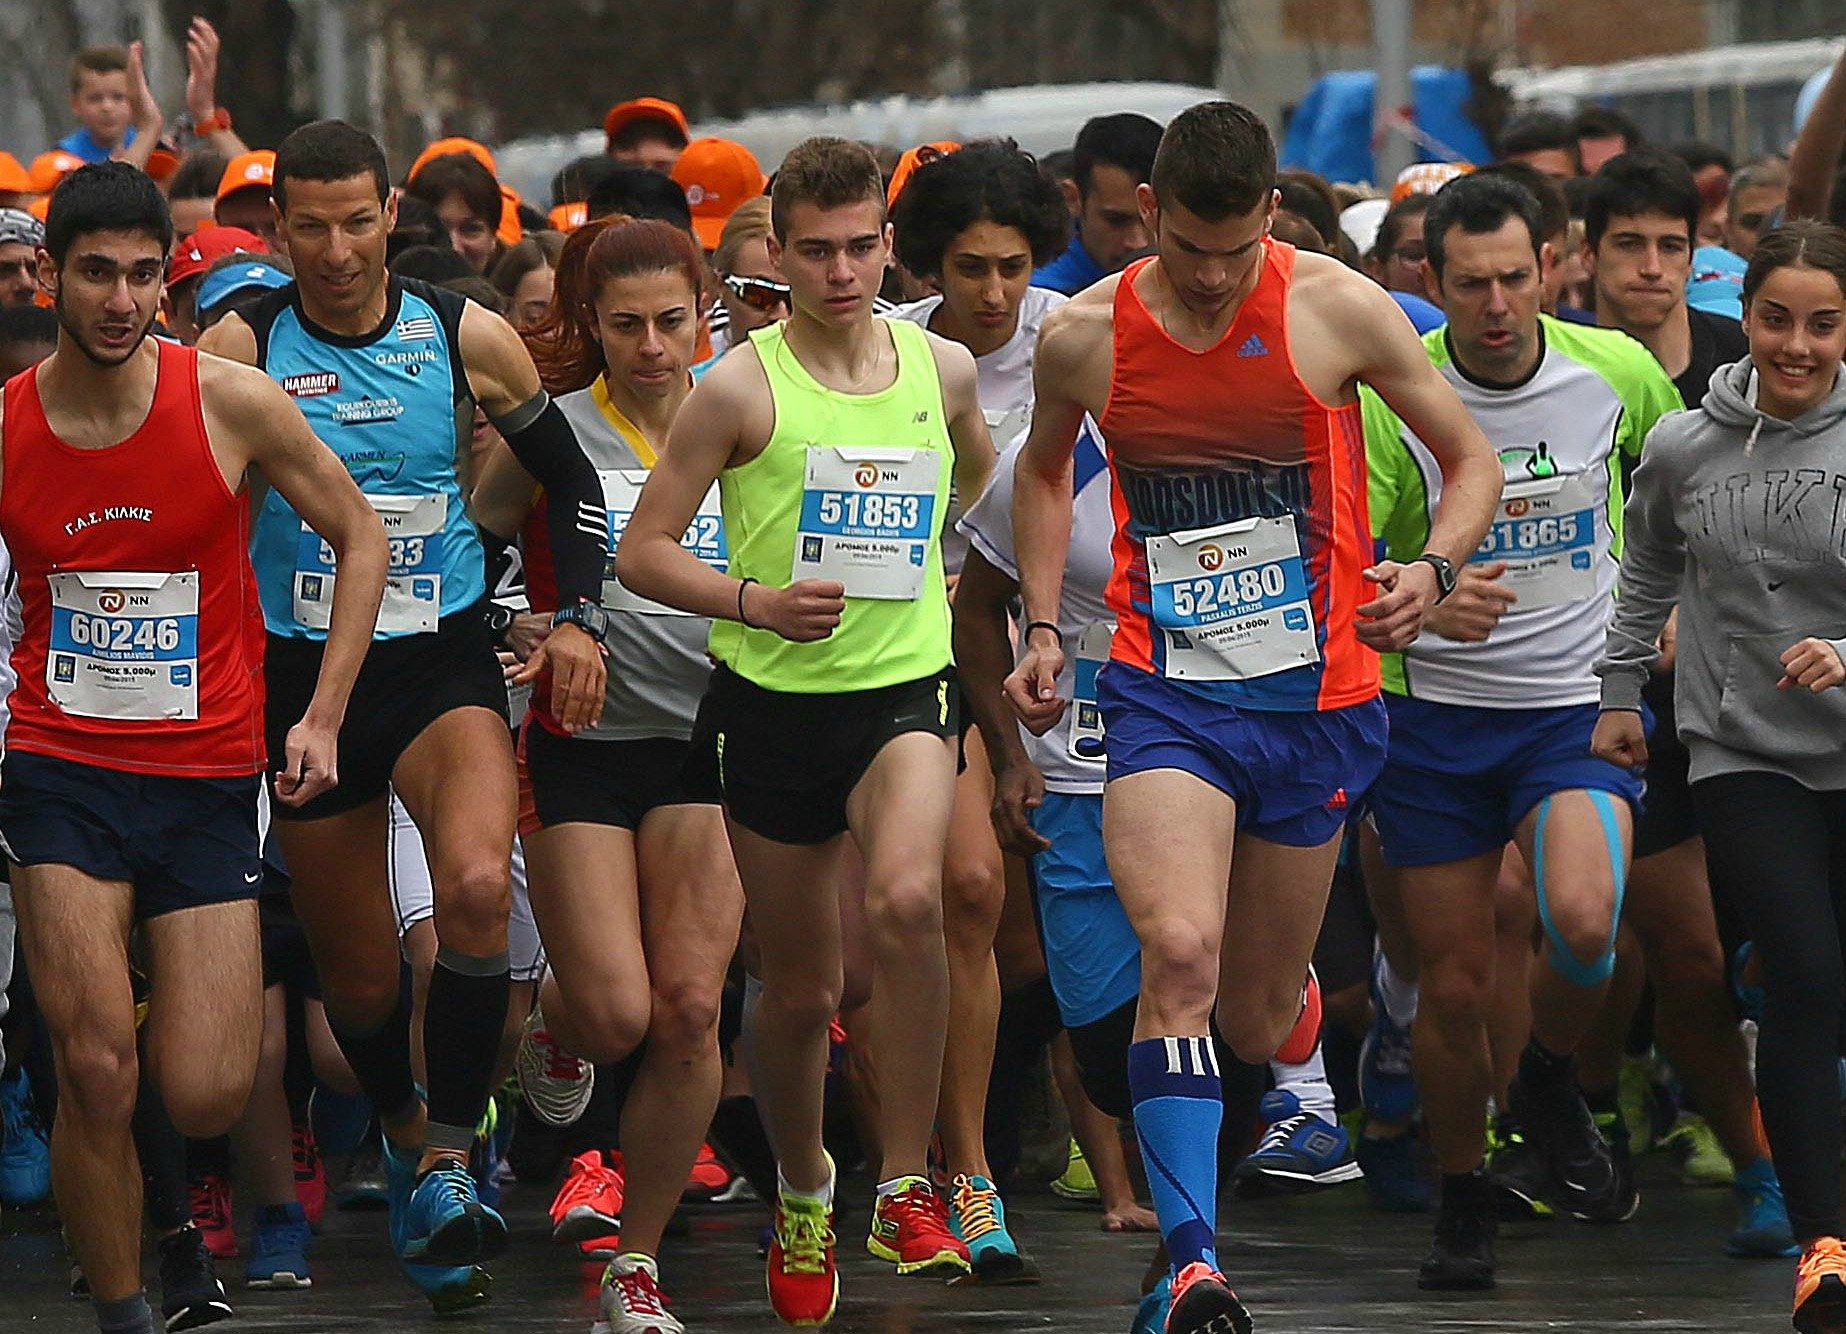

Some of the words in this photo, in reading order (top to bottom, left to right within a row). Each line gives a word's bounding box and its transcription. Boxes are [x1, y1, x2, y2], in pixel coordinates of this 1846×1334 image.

[375, 350, 436, 365] GARMIN
[284, 373, 337, 391] HAMMER
[881, 471, 899, 482] NN
[818, 492, 920, 530] 51853
[384, 517, 402, 527] NN
[612, 513, 720, 549] 562
[318, 537, 425, 567] 533
[1227, 545, 1248, 559] NN
[1172, 563, 1286, 617] 52480
[130, 596, 149, 605] NN
[70, 613, 179, 651] 60246
